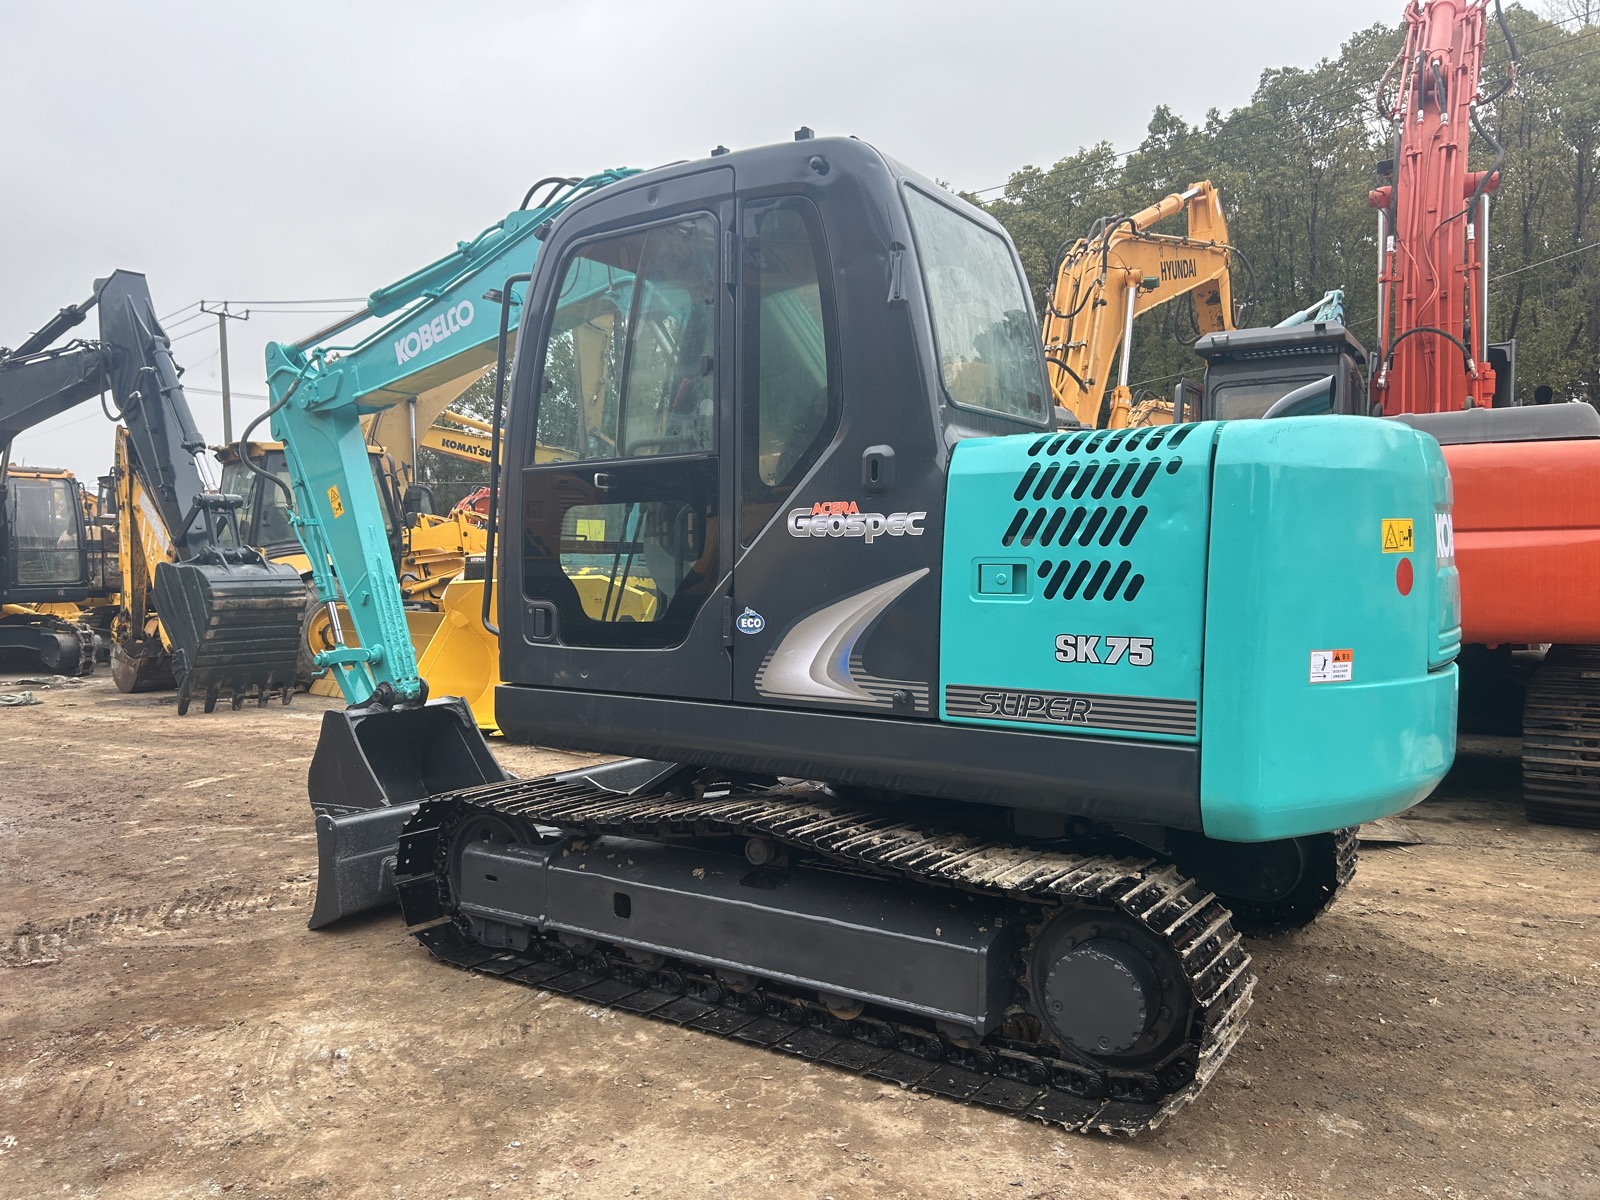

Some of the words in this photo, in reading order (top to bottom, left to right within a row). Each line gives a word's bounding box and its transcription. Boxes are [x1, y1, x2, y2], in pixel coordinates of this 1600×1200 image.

[1160, 258, 1197, 281] HYUNDAI
[394, 300, 475, 366] KOBELCO
[811, 500, 860, 516] ACERA
[741, 618, 762, 628] ECO
[976, 692, 1093, 724] SUPER
